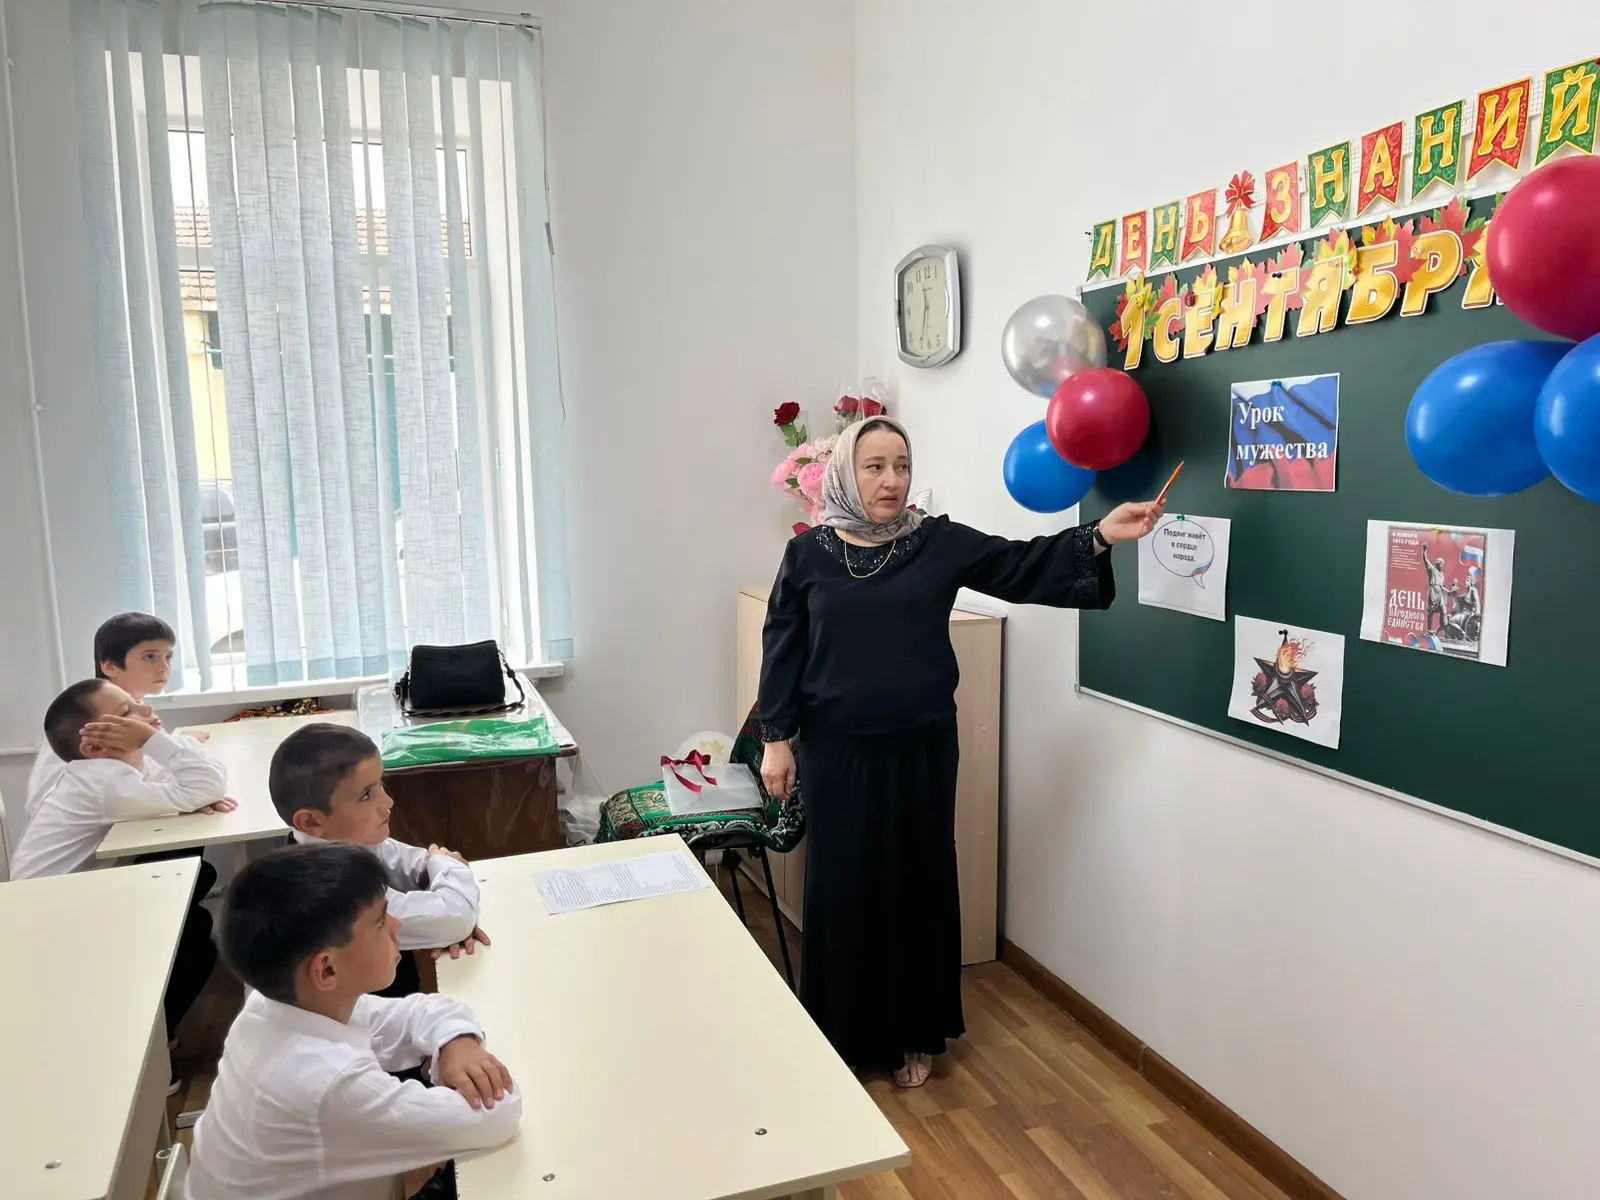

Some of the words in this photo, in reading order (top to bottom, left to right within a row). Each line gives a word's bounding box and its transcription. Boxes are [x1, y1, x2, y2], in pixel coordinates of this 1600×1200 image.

[1092, 197, 1210, 269] ДЕНЬ
[1270, 65, 1597, 224] ЗНАНИЙ
[1120, 291, 1146, 371] 1
[1238, 401, 1285, 430] Урок
[1236, 441, 1328, 466] мужества
[1164, 528, 1186, 537] Подвиг
[1389, 588, 1425, 611] ДЕНЬ
